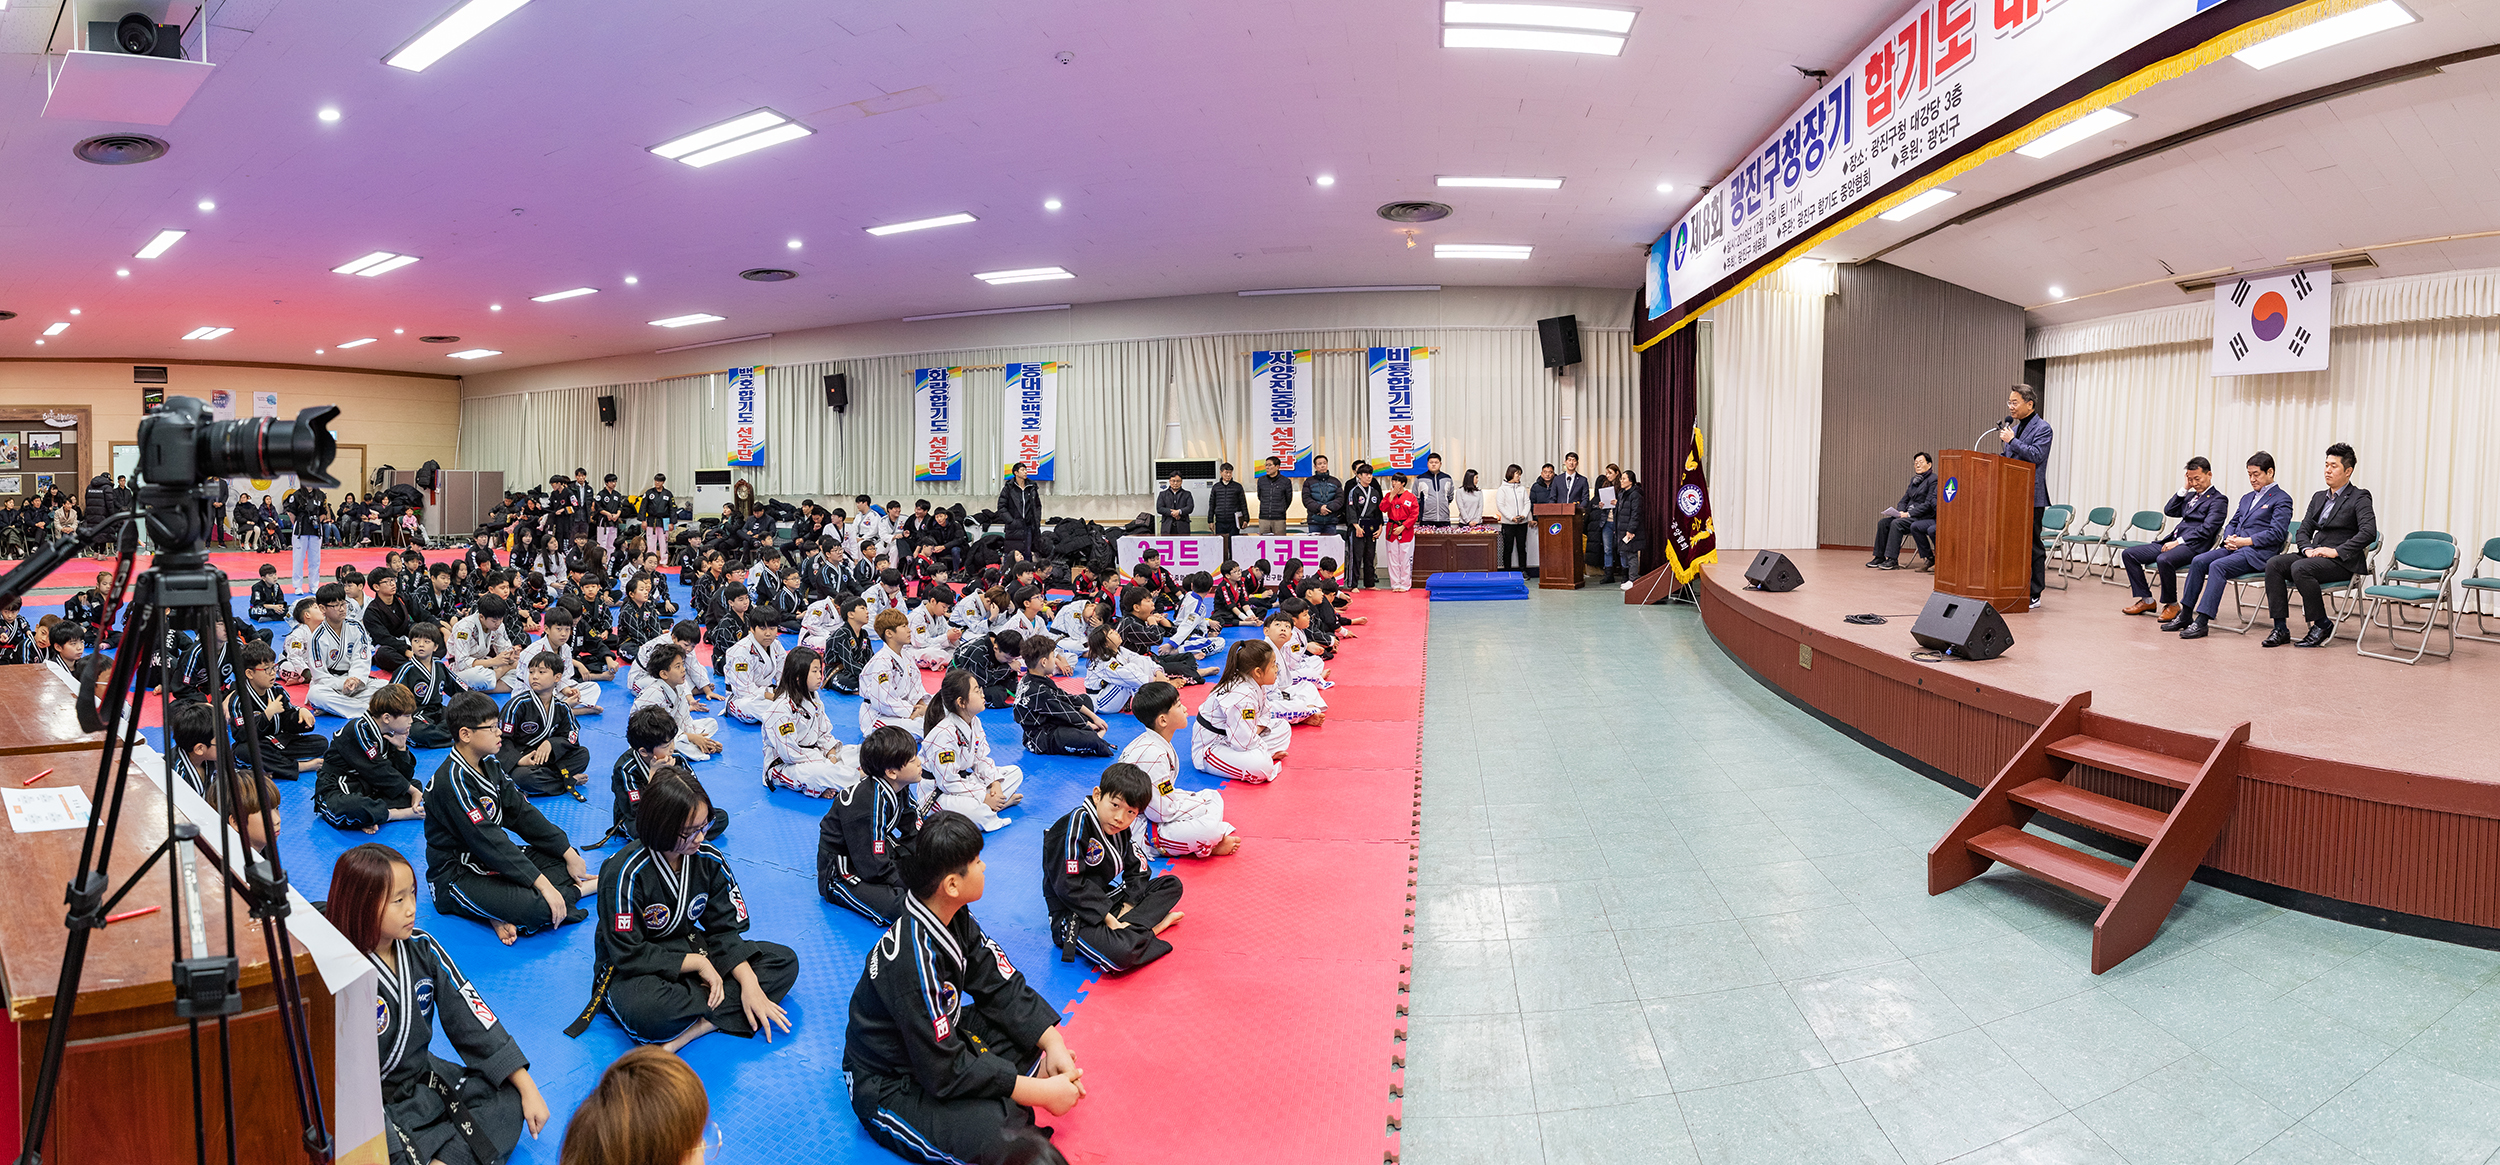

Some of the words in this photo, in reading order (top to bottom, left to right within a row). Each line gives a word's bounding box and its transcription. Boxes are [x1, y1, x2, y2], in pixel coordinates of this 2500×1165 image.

[1690, 189, 1724, 254] 제8회
[1730, 75, 1852, 227] 광진구청장기
[1864, 0, 1973, 128] 합기도
[1849, 147, 1868, 173] 장소:
[1871, 118, 1907, 158] 광진구청
[1910, 95, 1941, 132] 대강당
[1944, 83, 1963, 112] 3층
[1899, 137, 1924, 166] 후원:
[1927, 113, 1961, 150] 광진구
[1778, 200, 1788, 220] (토)
[1790, 190, 1803, 212] 11시
[1797, 203, 1816, 229] 광진구
[1818, 190, 1838, 216] 합기도
[1840, 167, 1871, 203] 중앙협회
[738, 367, 755, 423] 백호합기도
[928, 368, 949, 432] 화랑합기도
[1021, 363, 1041, 430] 동대문백호
[1268, 350, 1297, 423] 자양진중관
[1385, 347, 1414, 421] 비룡합기도
[737, 427, 753, 461] 선수단
[928, 436, 947, 474] 선수단
[1019, 434, 1039, 474] 선수단
[1270, 426, 1296, 470] 선수단
[1388, 424, 1413, 469] 선수단
[1256, 539, 1319, 567] 1코트
